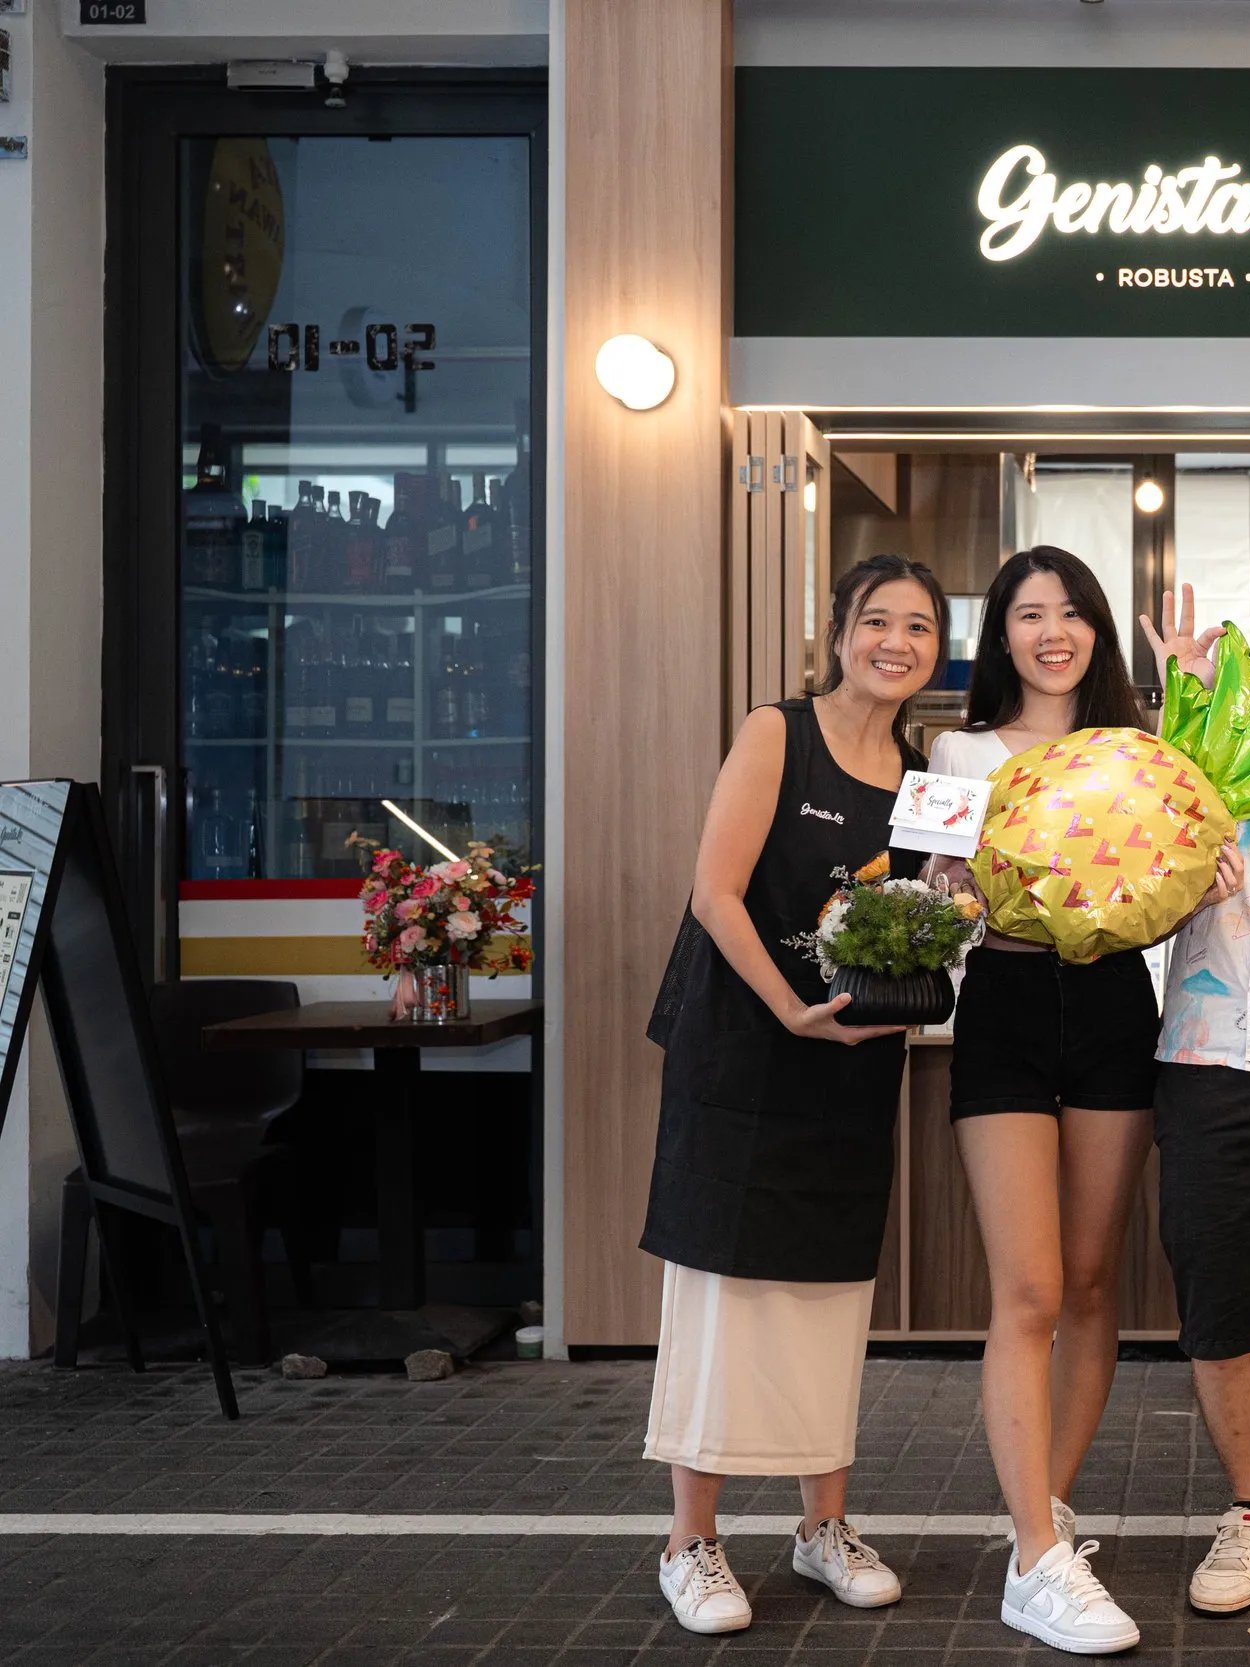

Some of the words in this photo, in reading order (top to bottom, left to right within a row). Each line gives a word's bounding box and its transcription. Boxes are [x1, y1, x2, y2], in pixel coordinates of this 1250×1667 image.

[89, 4, 136, 19] 01-02
[1118, 267, 1235, 288] ROBUSTA
[268, 323, 436, 372] 01-02
[800, 802, 833, 820] Genista
